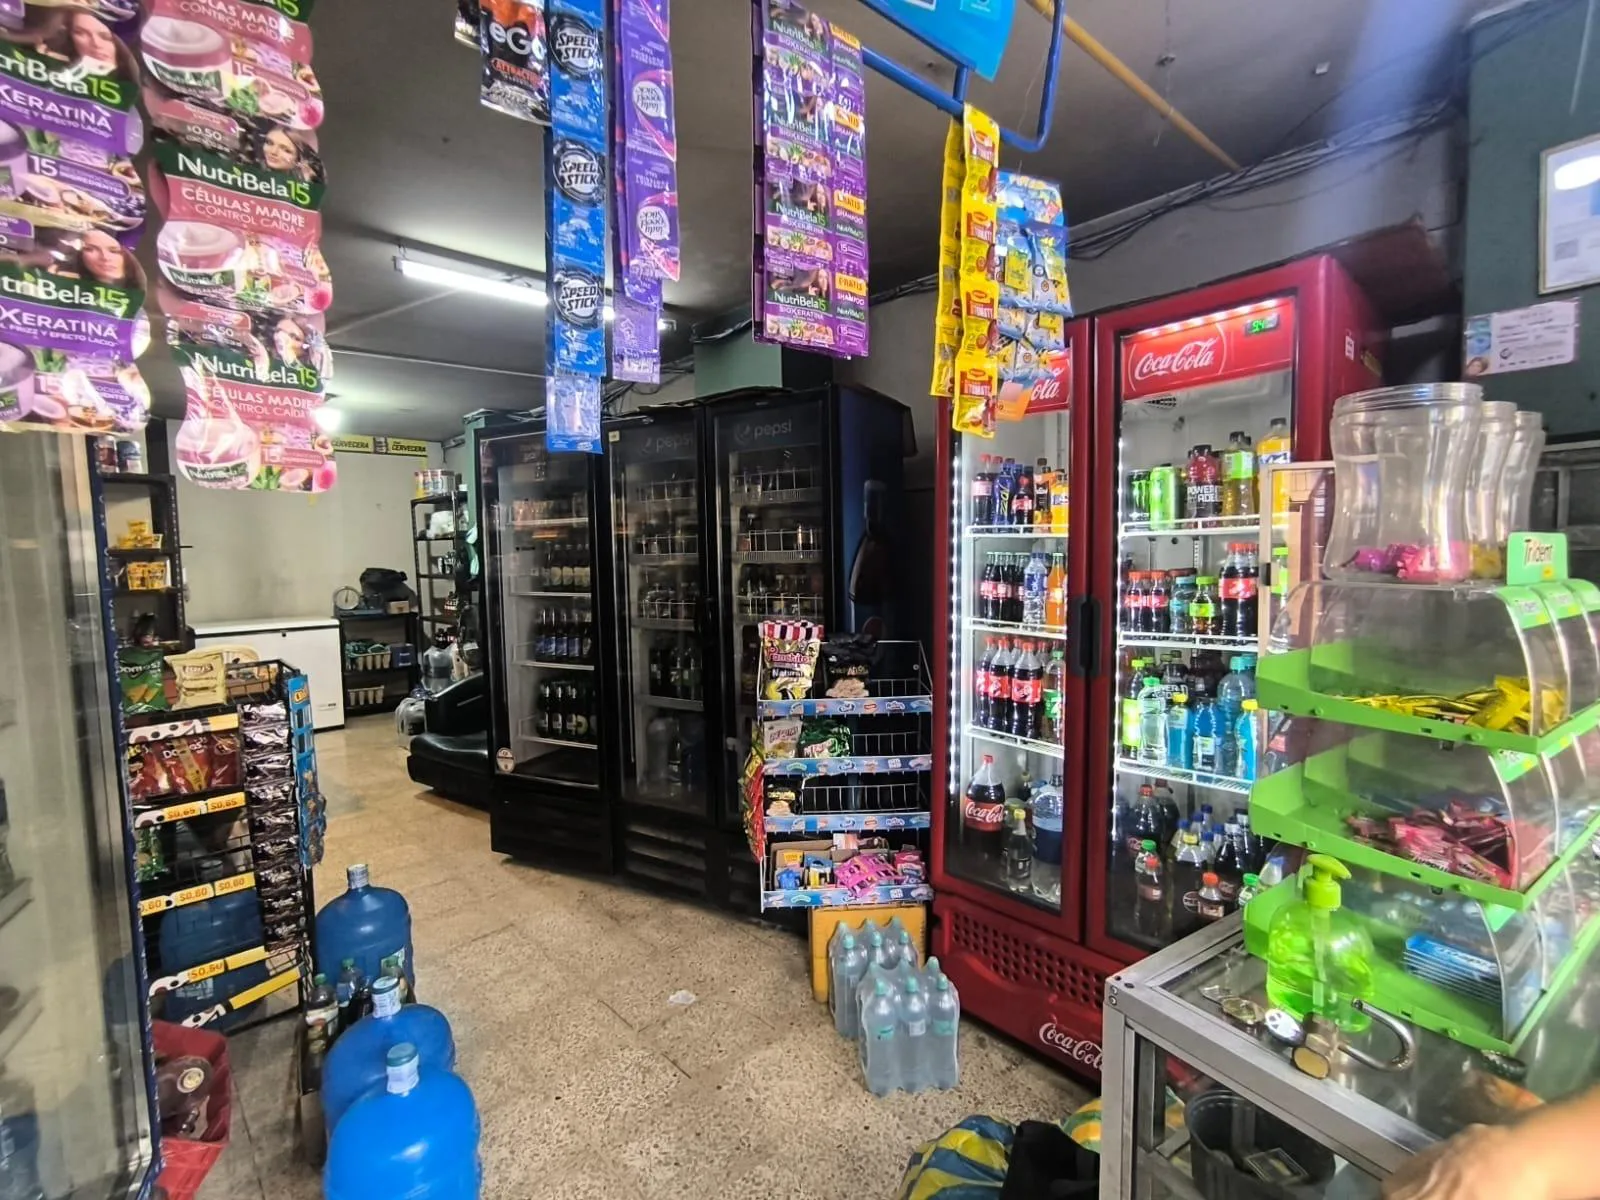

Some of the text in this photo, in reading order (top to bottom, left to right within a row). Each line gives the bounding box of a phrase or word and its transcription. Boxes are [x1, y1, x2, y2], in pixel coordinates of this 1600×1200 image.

[181, 2, 242, 29] CONTROL
[489, 22, 546, 60] eGo
[558, 32, 596, 48] SPEED
[563, 45, 596, 62] STICK
[29, 155, 58, 177] 15
[178, 153, 310, 205] NutriBela15
[566, 173, 599, 188] STICK
[181, 184, 304, 228] CÉLULAS MADRE
[195, 204, 256, 224] CONTROL
[562, 284, 598, 300] SPEED
[774, 291, 827, 311] NutriBela15
[566, 297, 598, 312] STICK
[49, 331, 86, 342] EFECTO
[1135, 337, 1217, 380] Coca-Cola
[754, 419, 792, 439] pepsi
